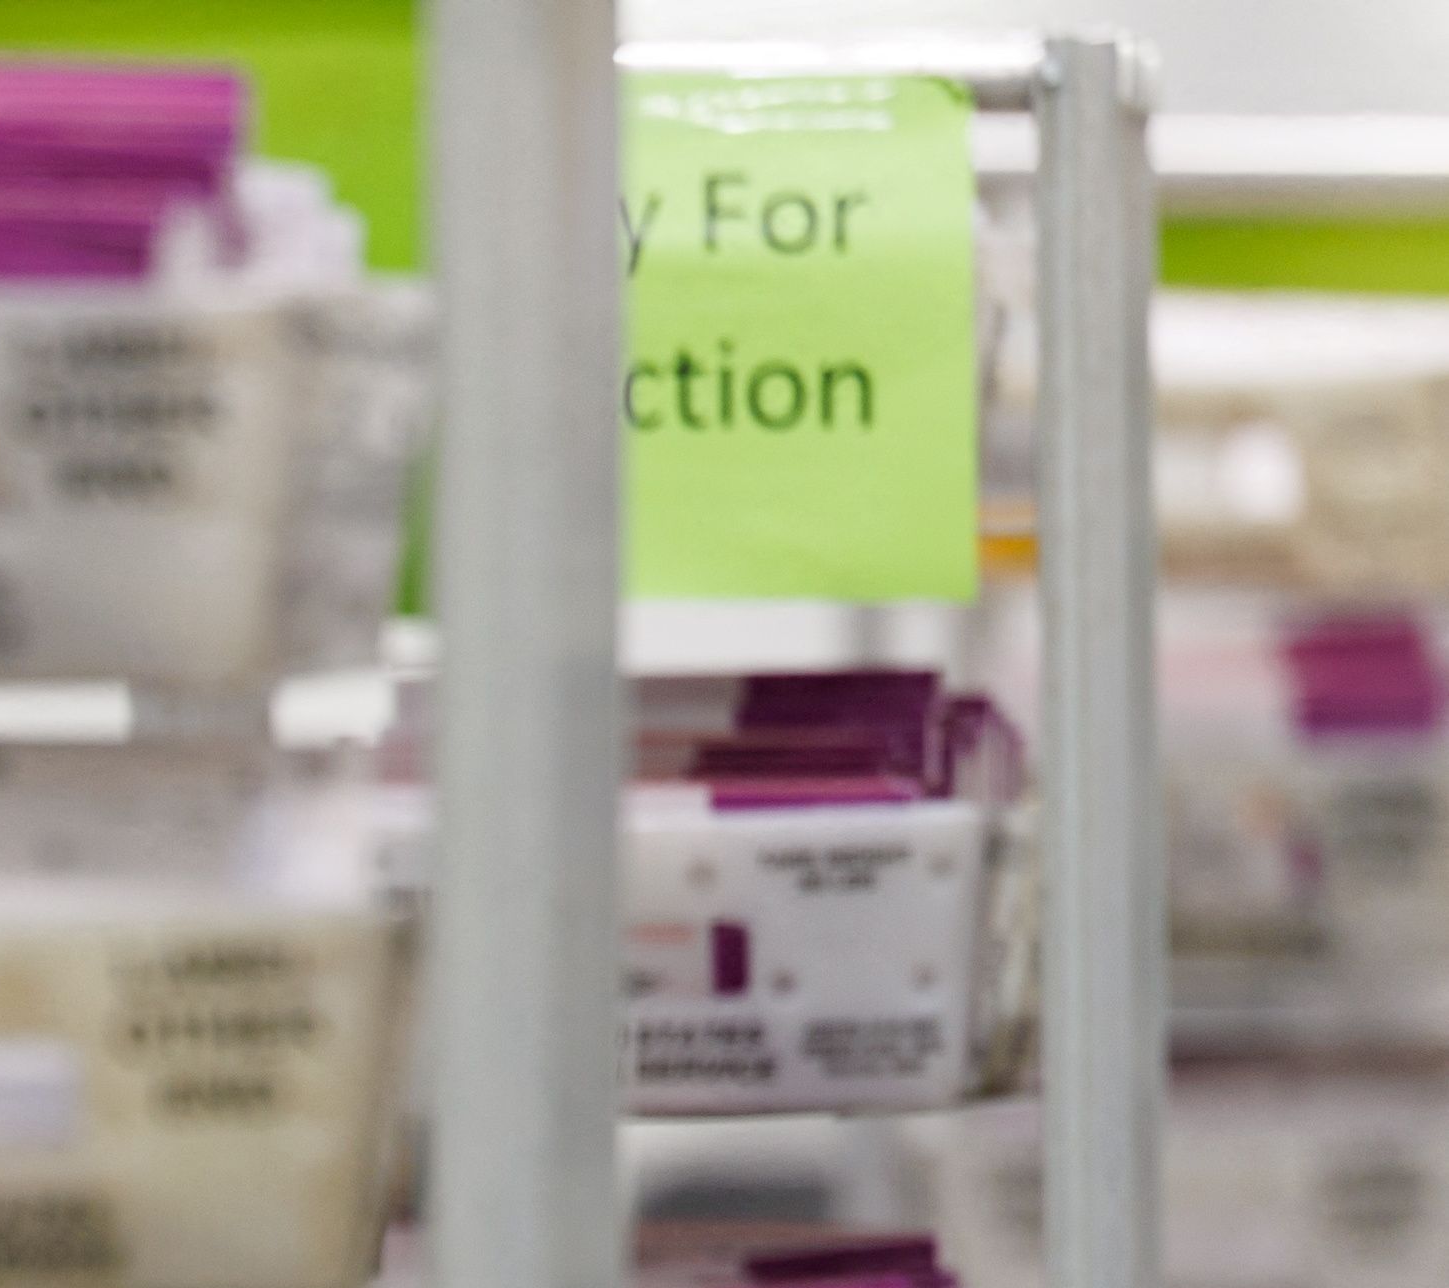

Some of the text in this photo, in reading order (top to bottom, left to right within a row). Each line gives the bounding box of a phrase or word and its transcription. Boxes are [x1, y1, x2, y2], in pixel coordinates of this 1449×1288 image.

[619, 168, 867, 278] y For
[622, 335, 875, 433] ction
